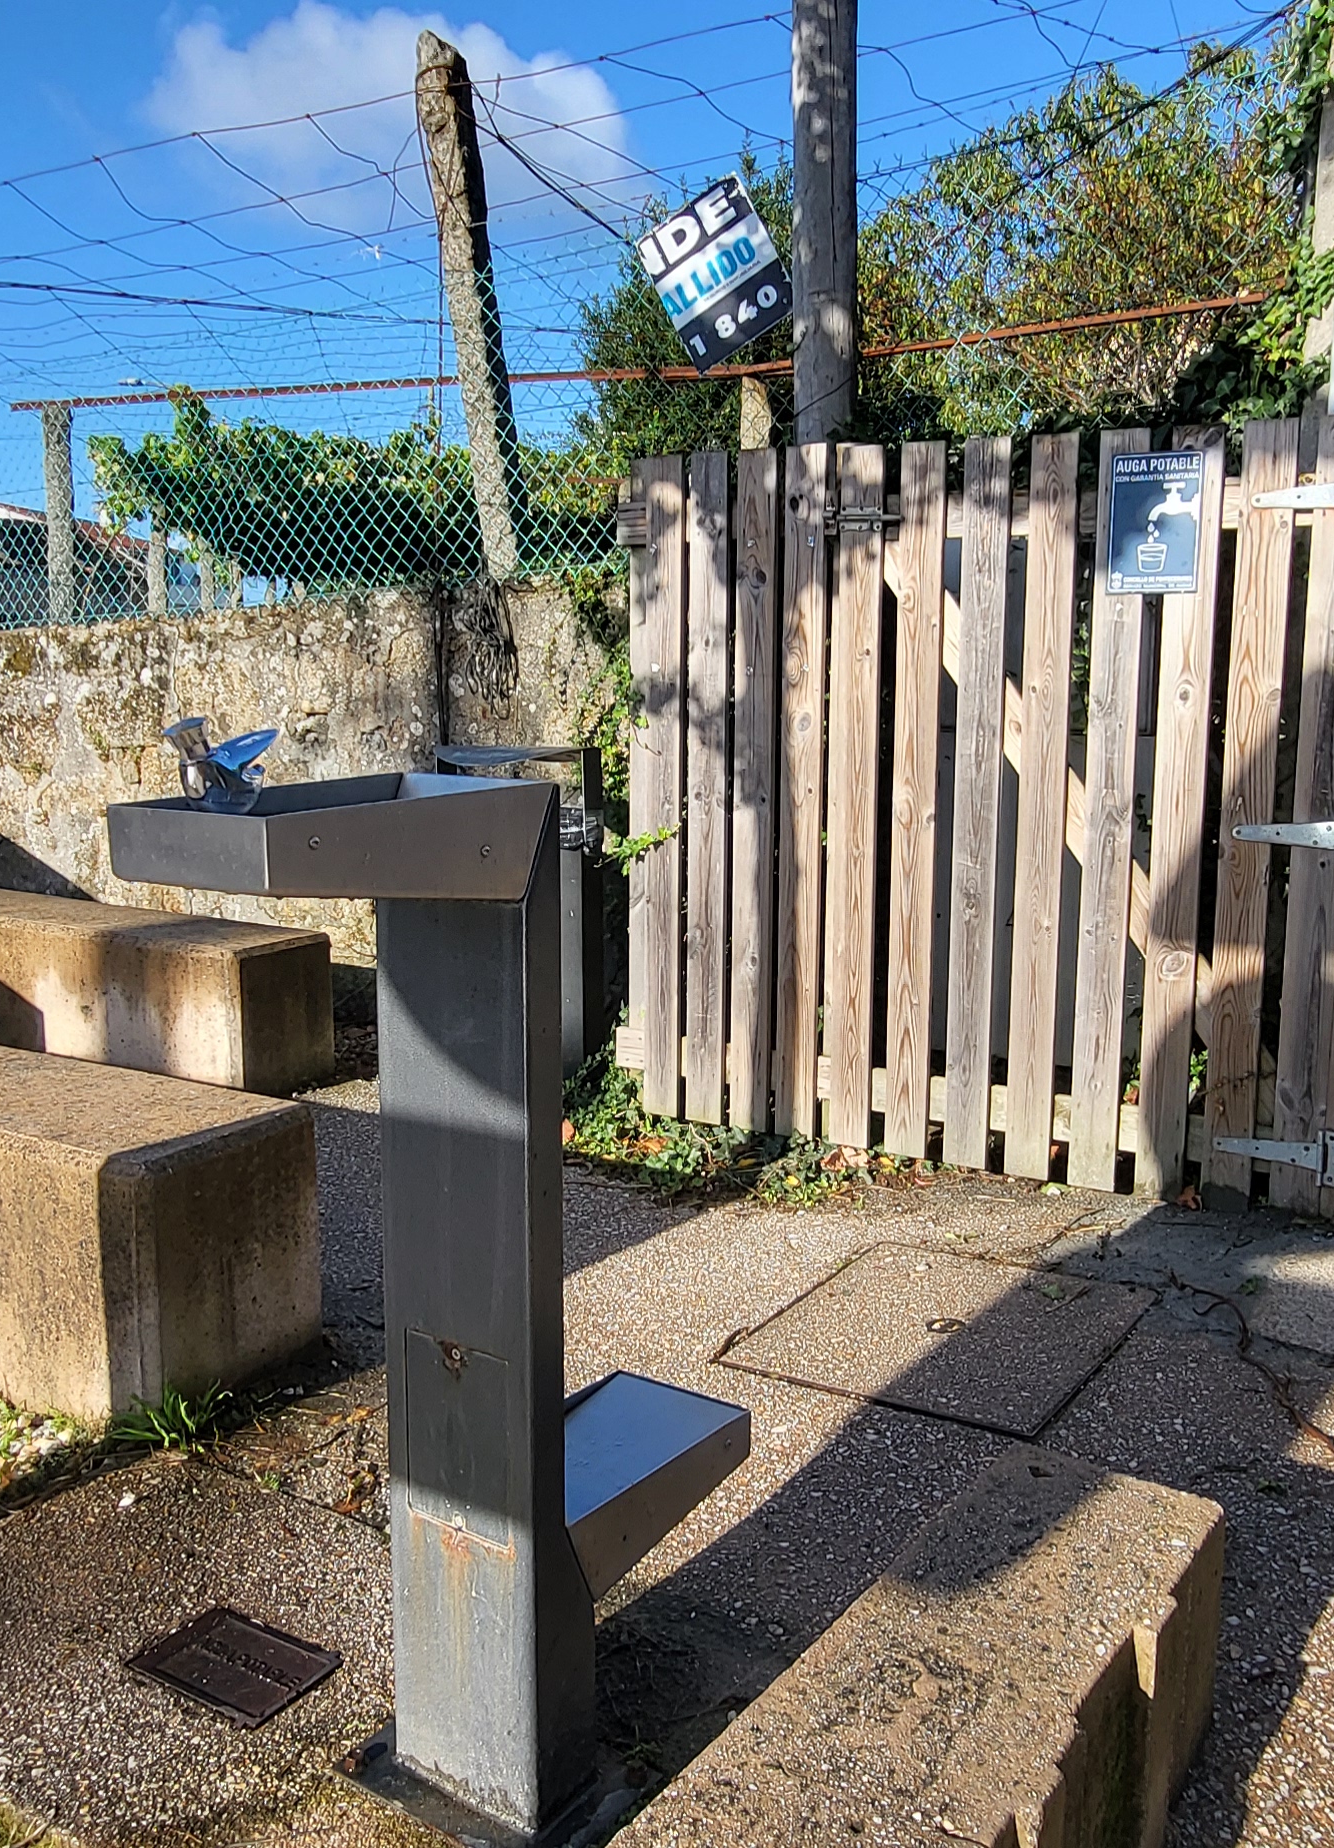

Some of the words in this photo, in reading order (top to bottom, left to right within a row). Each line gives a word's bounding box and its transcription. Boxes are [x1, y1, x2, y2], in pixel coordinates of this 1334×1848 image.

[1116, 459, 1148, 473] AUGA
[1150, 456, 1200, 472] POTABLE
[1115, 475, 1130, 483] CON
[1165, 471, 1200, 480] SANITARIA
